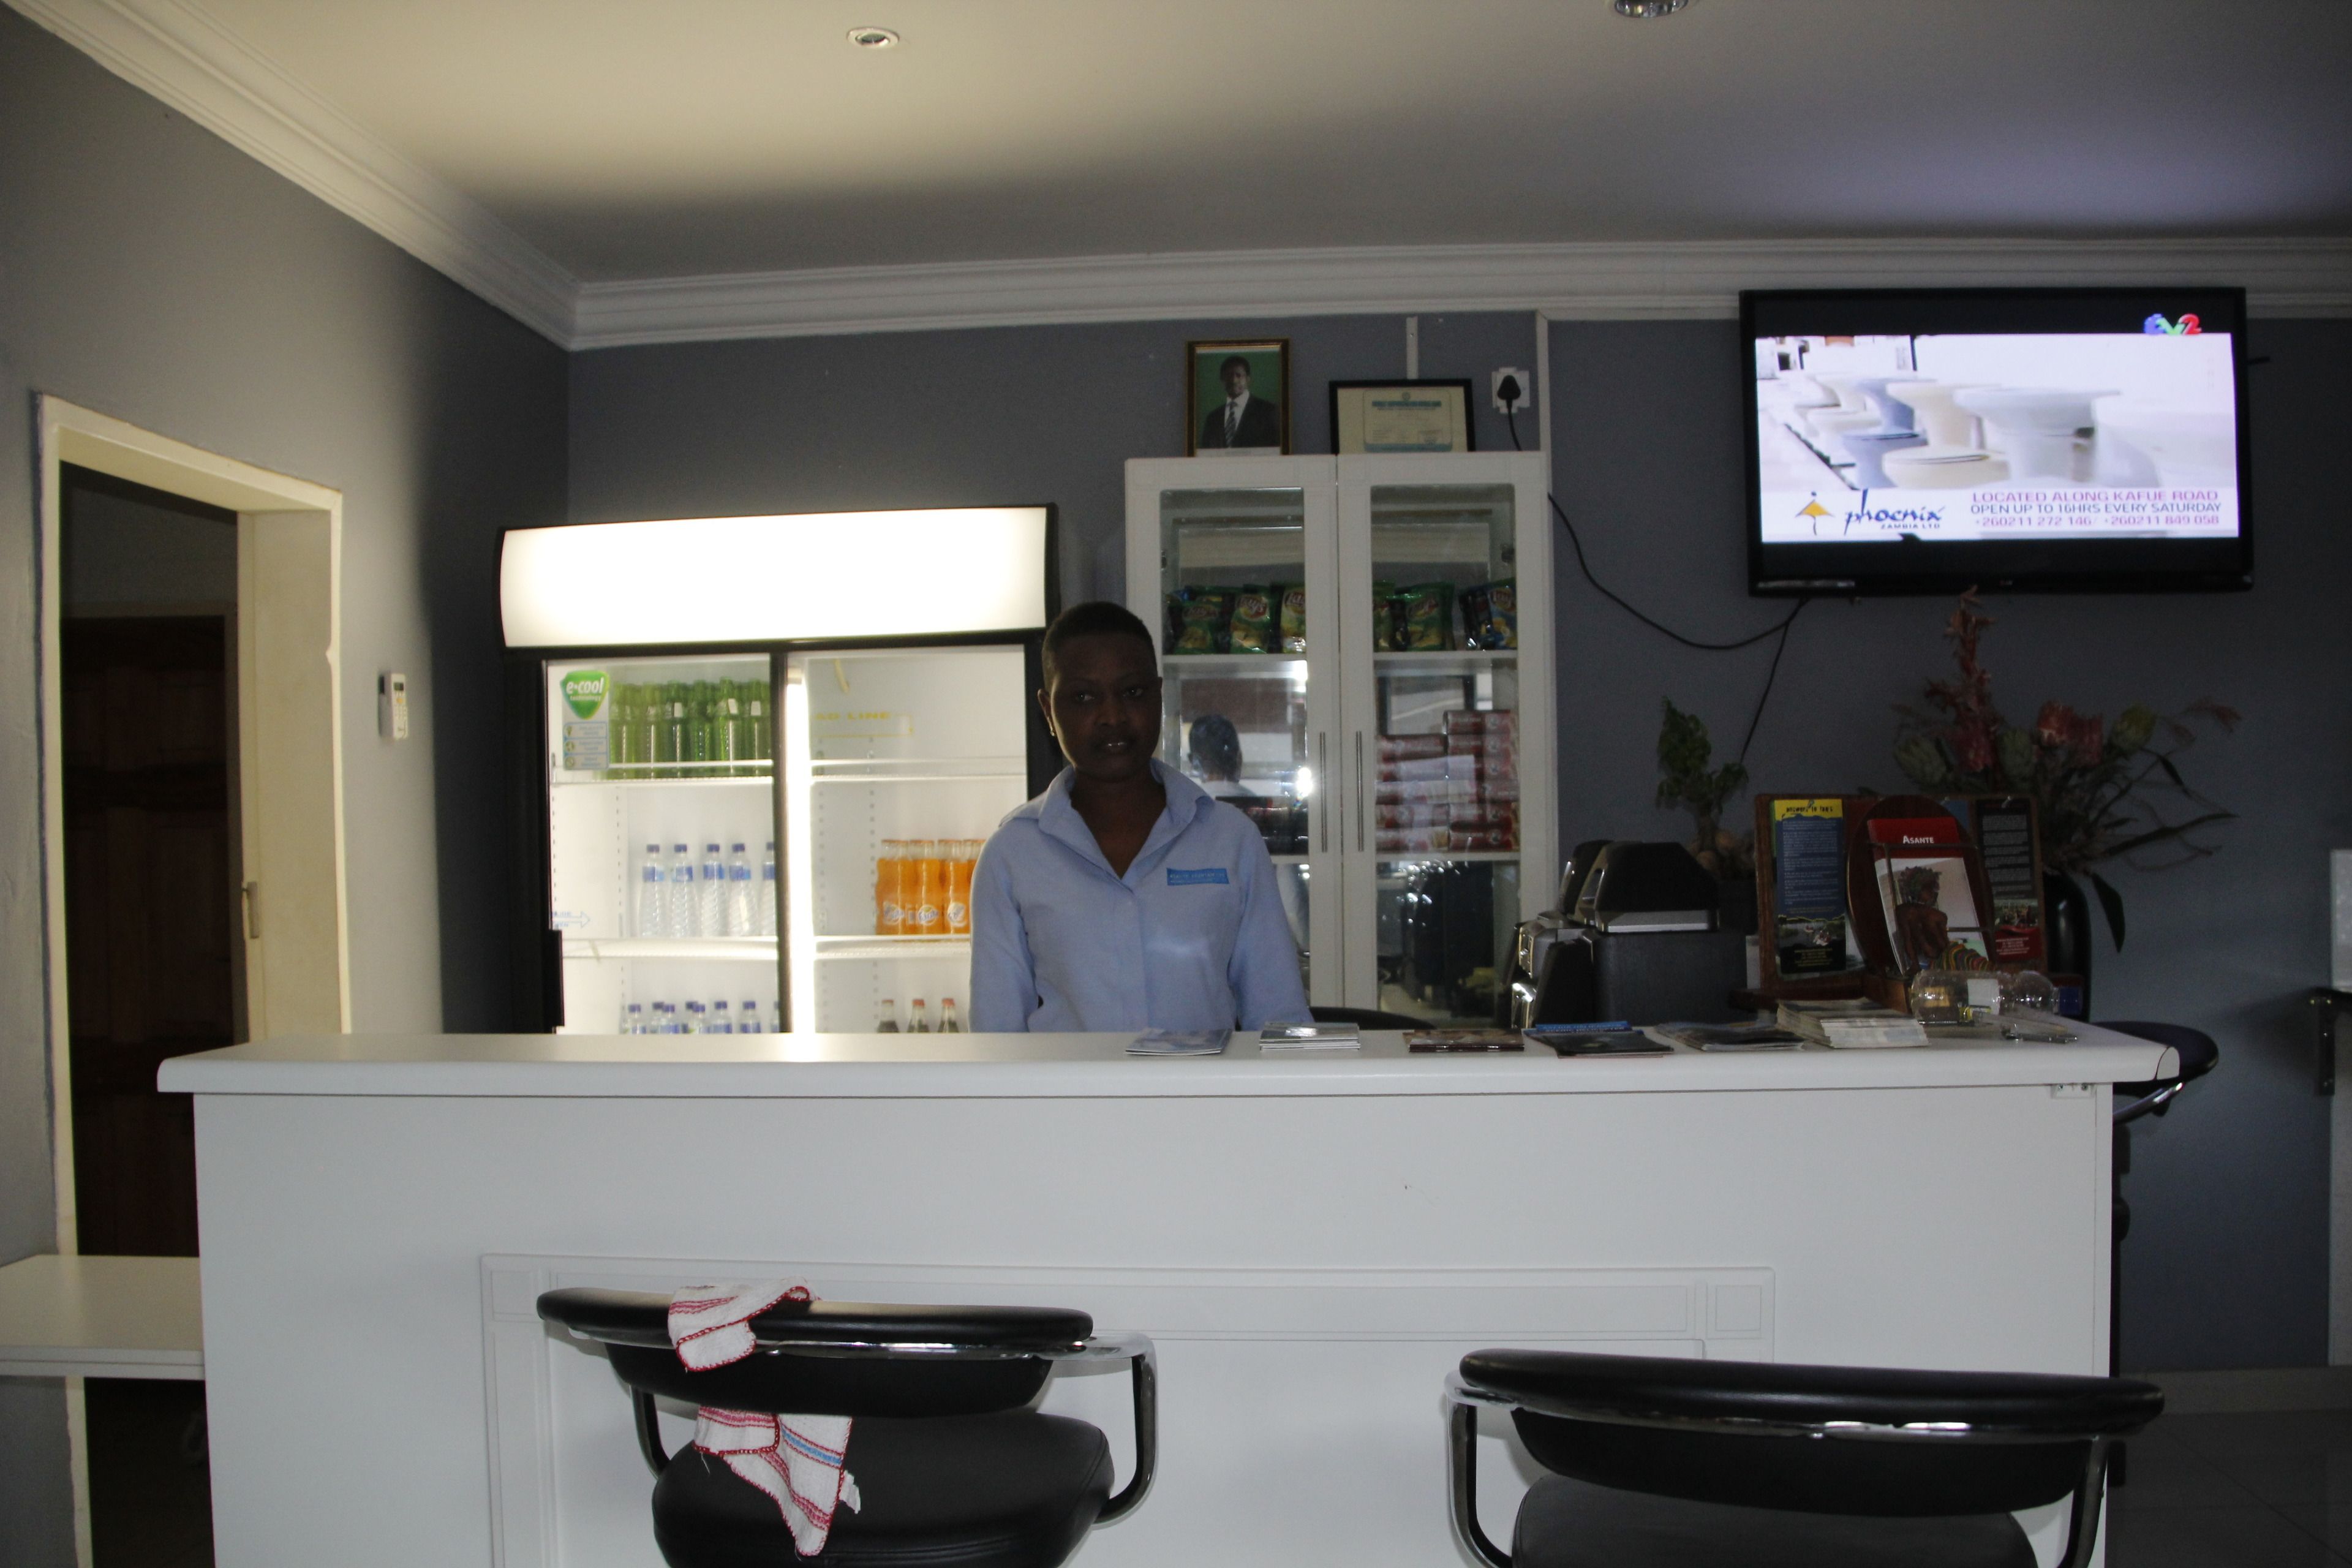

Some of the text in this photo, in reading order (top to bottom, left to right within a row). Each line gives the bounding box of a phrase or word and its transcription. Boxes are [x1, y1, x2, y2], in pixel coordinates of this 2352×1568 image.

[1972, 490, 2218, 503] LOCATED ALONG KAFUE ROAD
[1844, 488, 1946, 536] phoenix
[1970, 502, 2222, 514] OPEN UP TO 16HRS EVERY SATURDAY
[2037, 516, 2062, 526] 272
[2165, 515, 2190, 525] 849
[2194, 514, 2219, 525] 058
